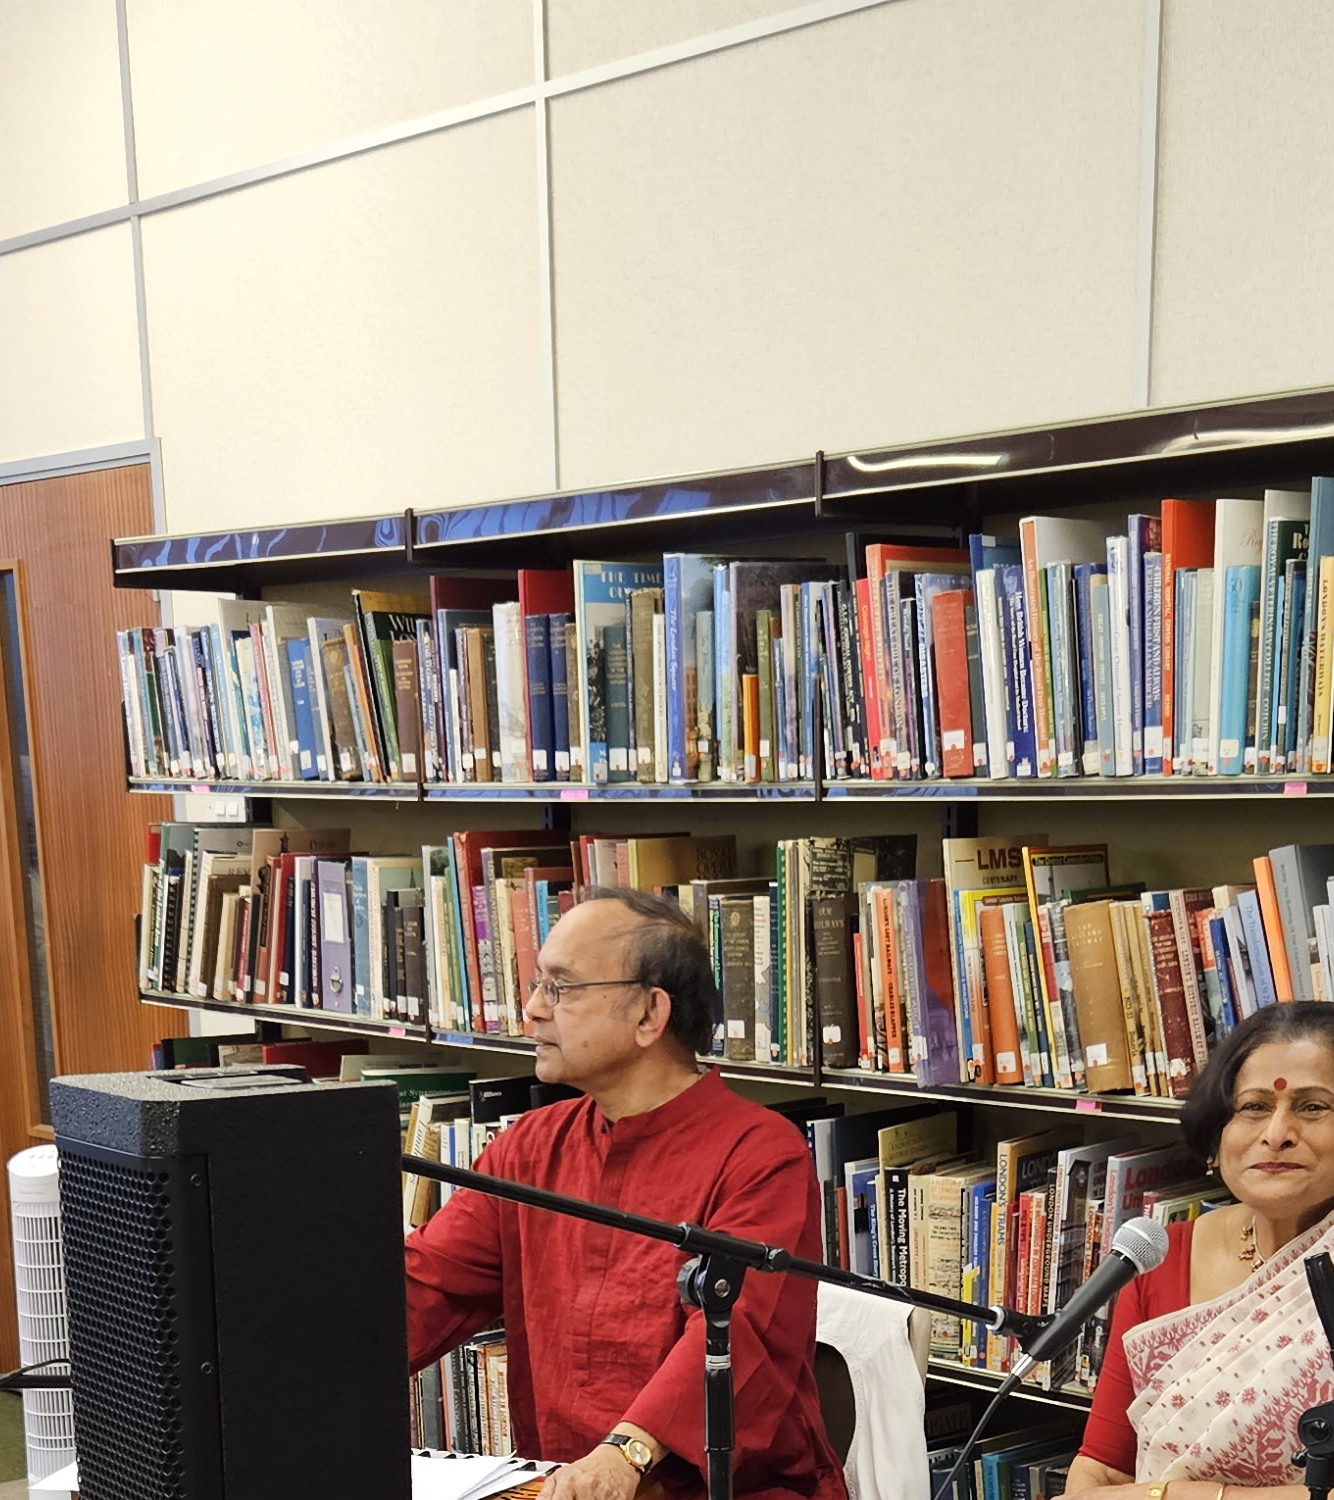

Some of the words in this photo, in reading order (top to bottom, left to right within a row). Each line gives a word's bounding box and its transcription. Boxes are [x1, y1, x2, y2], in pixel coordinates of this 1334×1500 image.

[977, 848, 1024, 870] LMS
[998, 1154, 1007, 1207] LONDON'S
[997, 1212, 1005, 1246] TRAMS
